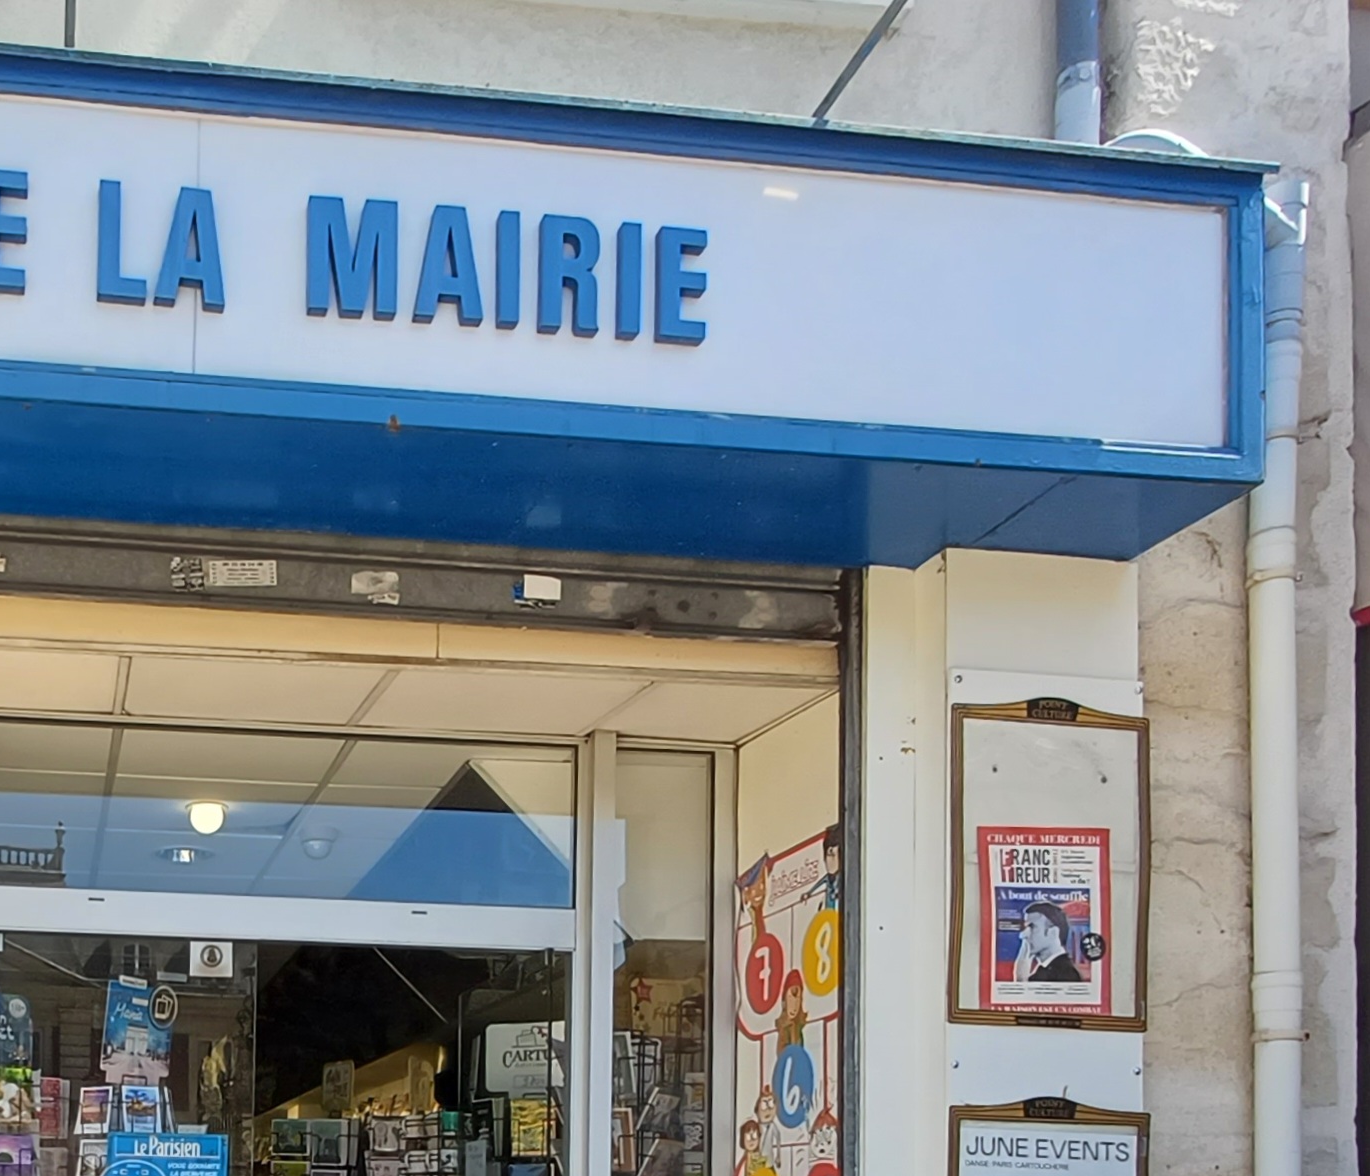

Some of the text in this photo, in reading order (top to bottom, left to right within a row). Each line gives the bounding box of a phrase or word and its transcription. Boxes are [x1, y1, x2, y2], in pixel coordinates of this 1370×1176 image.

[96, 180, 225, 314] LA
[305, 195, 708, 347] MAIRIE
[1040, 834, 1100, 845] MERCREDI
[1000, 848, 1051, 866] FRANC
[1000, 866, 1051, 884] TIREUR
[1034, 890, 1048, 901] de
[815, 920, 832, 985] 8
[756, 946, 772, 1001] 7
[782, 1057, 802, 1115] 6
[133, 1134, 201, 1157] Le Parisien
[966, 1136, 1130, 1162] JUNE EVENTS
